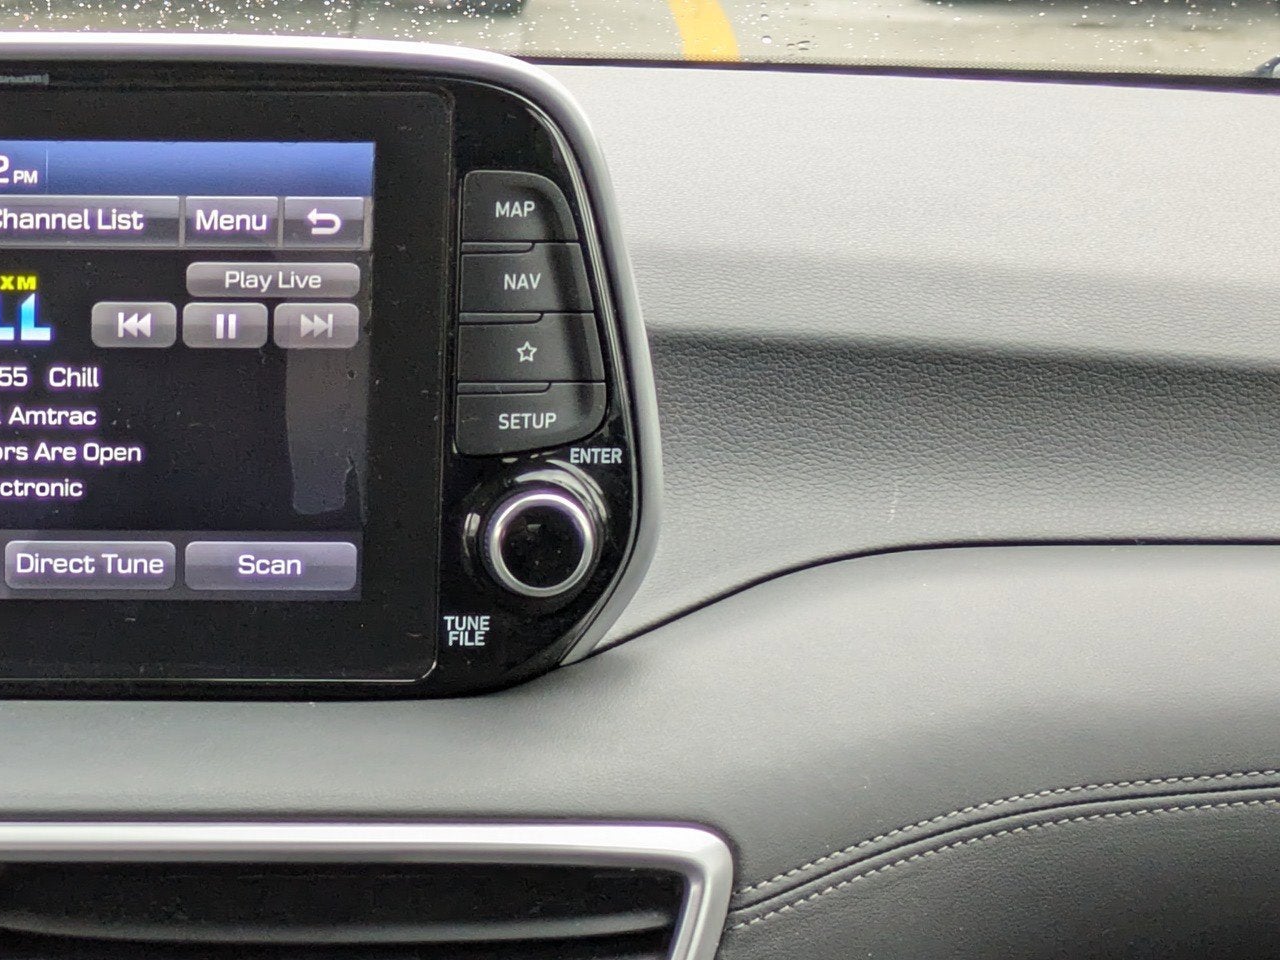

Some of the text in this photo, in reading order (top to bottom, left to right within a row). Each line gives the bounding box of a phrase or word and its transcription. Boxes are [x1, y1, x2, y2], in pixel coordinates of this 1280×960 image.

[13, 169, 39, 184] PM
[495, 200, 535, 218] MAP
[97, 208, 144, 231] List
[195, 208, 268, 231] Menu
[224, 270, 322, 293] Play Live
[504, 272, 542, 290] NAV
[48, 366, 100, 388] Chill
[8, 406, 97, 426] Amtrac
[498, 412, 557, 430] SETUP
[33, 441, 77, 462] Are
[82, 442, 142, 466] Open
[570, 448, 623, 464] ENTER
[16, 552, 165, 574] Direct Tune
[238, 553, 302, 575] Scan
[443, 615, 490, 631] TUNE
[448, 630, 486, 647] FILE
